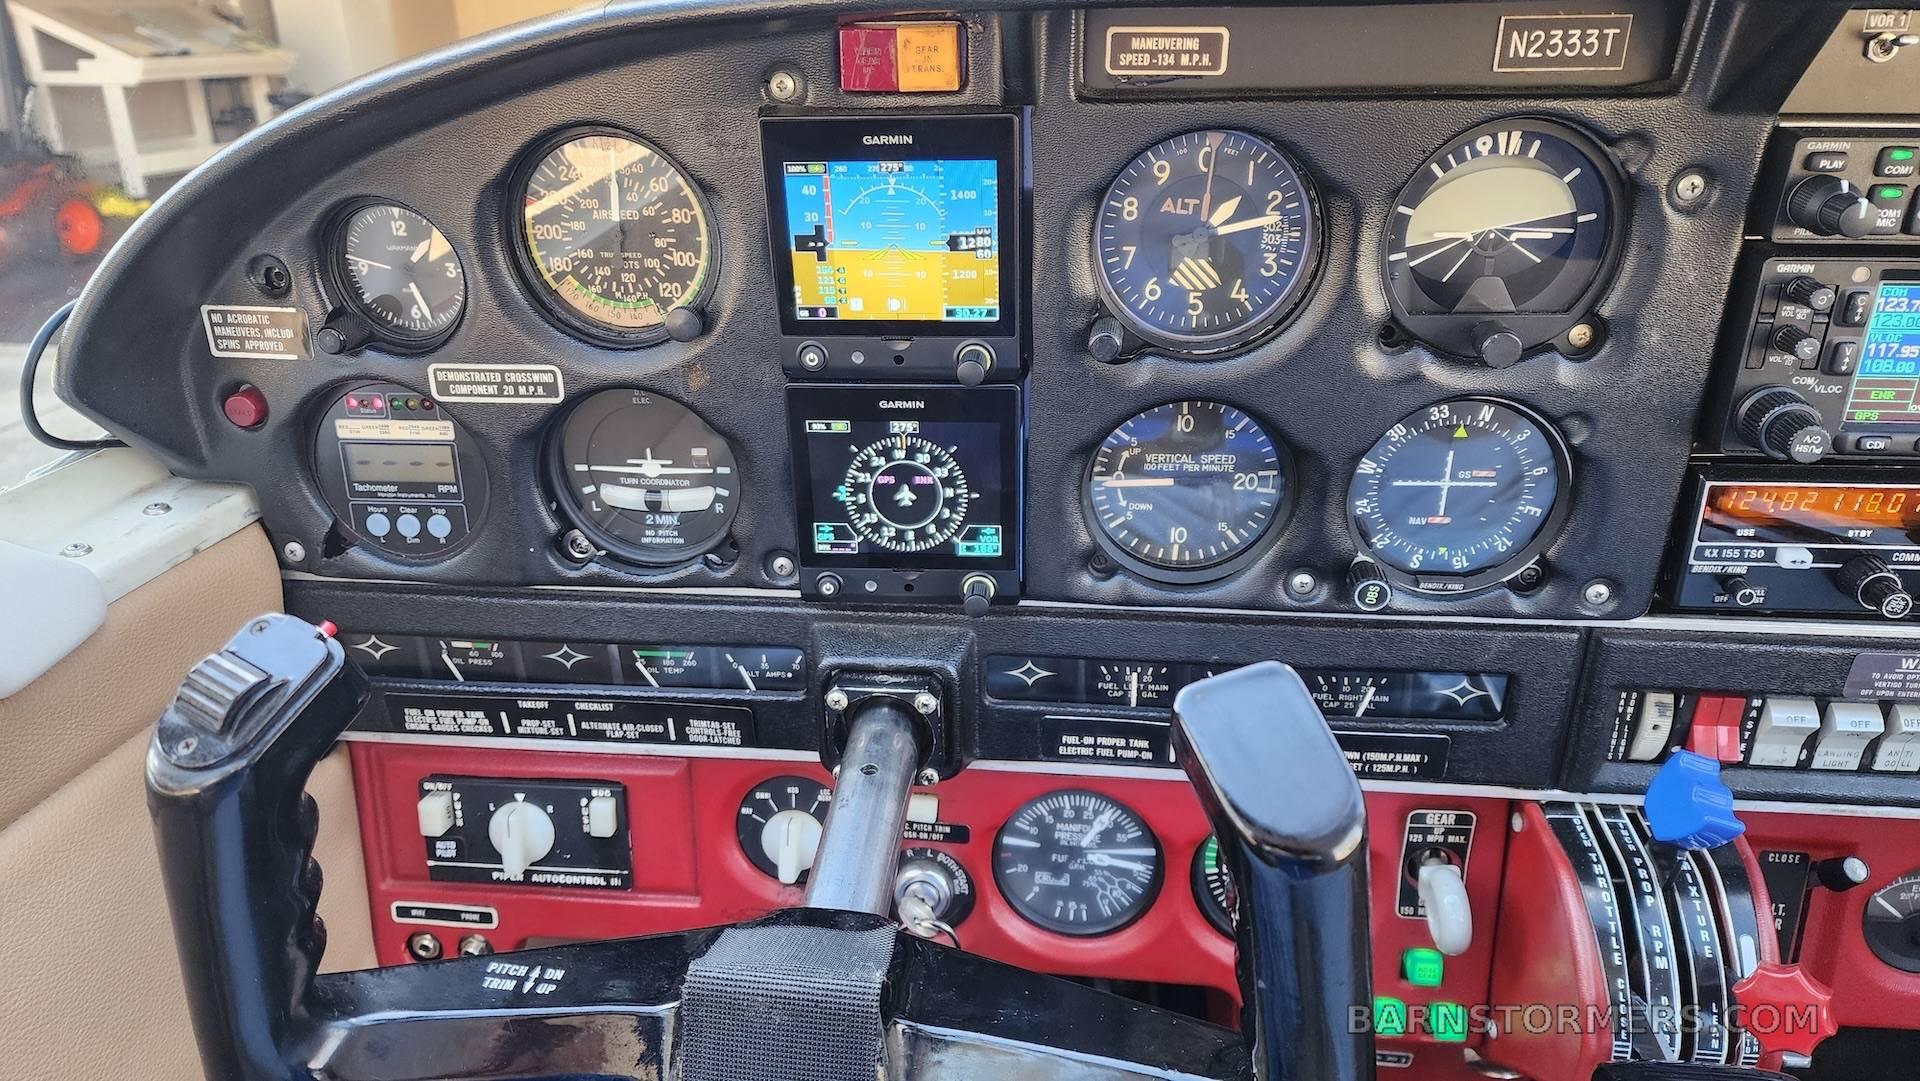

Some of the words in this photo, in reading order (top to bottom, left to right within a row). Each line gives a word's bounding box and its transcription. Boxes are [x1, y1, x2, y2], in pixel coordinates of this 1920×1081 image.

[1870, 15, 1894, 27] VOR
[1900, 15, 1907, 26] 1
[1132, 37, 1200, 50] MANEUVERING
[1509, 29, 1621, 58] N2333T
[915, 45, 939, 54] GEAR
[1120, 53, 1150, 66] SPEED
[1181, 54, 1212, 66] M.P.H.
[863, 135, 913, 145] GARMIN
[1808, 142, 1851, 150] GARMIN
[1819, 161, 1845, 169] PLAY
[1884, 165, 1914, 175] COM1
[1153, 160, 1170, 186] 9
[1248, 161, 1255, 186] 1
[650, 177, 668, 192] 60
[802, 185, 816, 196] 40
[951, 190, 976, 200] 1400
[580, 199, 599, 209] 200
[1160, 197, 1200, 215] ALT
[1265, 190, 1283, 216] 2
[643, 206, 655, 216] 60
[1123, 197, 1139, 221] 8
[672, 208, 691, 224] 80
[804, 213, 818, 222] 30
[391, 221, 407, 236] 12
[570, 221, 586, 231] 180
[1876, 219, 1896, 227] MIC
[535, 225, 562, 240] 200
[655, 238, 667, 247] 80
[1261, 233, 1281, 244] 303
[577, 249, 594, 258] 160
[1122, 246, 1137, 270] 7
[551, 257, 572, 271] 180
[644, 258, 660, 269] 100
[673, 252, 695, 267] 100
[1259, 253, 1278, 277] 3
[358, 262, 368, 275] 9
[446, 263, 457, 277] 3
[594, 266, 611, 276] 140
[1777, 264, 1815, 273] GARMIN
[621, 272, 636, 283] 120
[953, 270, 977, 279] 1200
[659, 283, 682, 297] 120
[1145, 277, 1162, 301] 6
[1230, 279, 1249, 302] 4
[1882, 287, 1908, 297] COM
[1188, 292, 1204, 315] 5
[411, 305, 422, 318] 6
[211, 313, 223, 323] NO
[227, 314, 270, 325] ACROBATIC
[214, 326, 263, 339] MANEUVERS,
[1870, 334, 1903, 342] VLOC
[217, 339, 241, 350] SPINS
[1868, 343, 1920, 358] 117.95
[1863, 359, 1916, 373] 108.00
[436, 370, 501, 382] DEMONSTRATED
[504, 372, 554, 383] CROSSWIND
[449, 384, 498, 395] COMPONENT
[503, 385, 515, 395] 20
[519, 385, 546, 396] M.P.H.
[1870, 391, 1896, 400] ENR
[879, 400, 925, 409] GARMIN
[1429, 404, 1450, 421] 33
[1479, 405, 1495, 422] N
[1855, 412, 1879, 420] GPS
[1176, 414, 1195, 433] 10
[1225, 430, 1236, 439] 15
[1386, 423, 1407, 442] 30
[1517, 429, 1531, 442] 3
[1866, 441, 1885, 450] CDI
[1129, 447, 1141, 456] UP
[1145, 453, 1195, 464] VERTICAL
[1201, 454, 1237, 465] SPEED
[1157, 463, 1179, 472] FEET
[1183, 464, 1200, 472] PER
[1201, 464, 1235, 473] MINUTE
[1356, 457, 1377, 475] W
[620, 477, 639, 485] TURN
[640, 478, 690, 487] COORDINATOR
[877, 475, 896, 485] GPS
[1233, 472, 1259, 491] 20
[353, 483, 398, 492] Tachometer
[438, 484, 458, 493] RPM
[367, 505, 388, 513] Hours
[399, 506, 417, 514] Clear
[592, 501, 601, 512] L
[715, 503, 724, 514] R
[1129, 503, 1153, 511] DOWN
[1356, 498, 1372, 515] 24
[1218, 521, 1228, 532] 15
[1408, 516, 1427, 526] NAV
[1170, 526, 1188, 544] 10
[1736, 528, 1756, 537] USE
[1847, 529, 1873, 538] STBY
[641, 537, 684, 545] INFORMATION
[1704, 548, 1720, 558] KX
[1722, 549, 1741, 559] 155
[1743, 549, 1765, 559] TSO
[1410, 553, 1424, 569] S
[1453, 554, 1470, 570] 15
[1691, 564, 1748, 574] BENDIX/KING
[1419, 582, 1465, 591] BENDIX/KING
[1365, 585, 1380, 605] OBS
[468, 658, 493, 667] PRESS
[664, 667, 685, 675] TEMP
[765, 671, 786, 679] AMPS
[1098, 682, 1119, 690] FUEL
[1148, 684, 1169, 692] MAIN
[1141, 691, 1159, 699] GAL
[1312, 693, 1334, 701] FUEL
[1339, 694, 1363, 702] RIGHT
[517, 700, 549, 709] TAKEOFF
[575, 702, 614, 711] CHECKLIST
[581, 721, 621, 731] ALTERNATE
[622, 723, 664, 733] AIR-CLOSED
[689, 719, 736, 730] TRIMTAB-SET
[1851, 720, 1872, 729] OFF
[1062, 735, 1095, 746] FUEL-ON
[1097, 736, 1126, 747] PROPER
[1128, 738, 1150, 749] TANK
[1059, 746, 1095, 756] ELECTRIC
[1096, 748, 1115, 758] FUEL
[1117, 749, 1153, 760] PUMP-ON
[1823, 760, 1849, 768] LIGHT
[1426, 813, 1456, 825] GEAR
[913, 823, 933, 832] PITCH
[1408, 834, 1423, 843] 125
[1426, 834, 1444, 843] MPH
[1768, 853, 1801, 864] CLOSE
[531, 873, 607, 886] AUTOCONTROL
[1588, 852, 1623, 966] THROTTLE
[1633, 857, 1655, 907] PROP
[1651, 925, 1669, 970] RPM
[1680, 860, 1713, 958] MIXTURE
[486, 962, 529, 977] PITCH
[543, 968, 565, 980] DN
[482, 976, 517, 991] TRIM
[535, 982, 557, 995] UP
